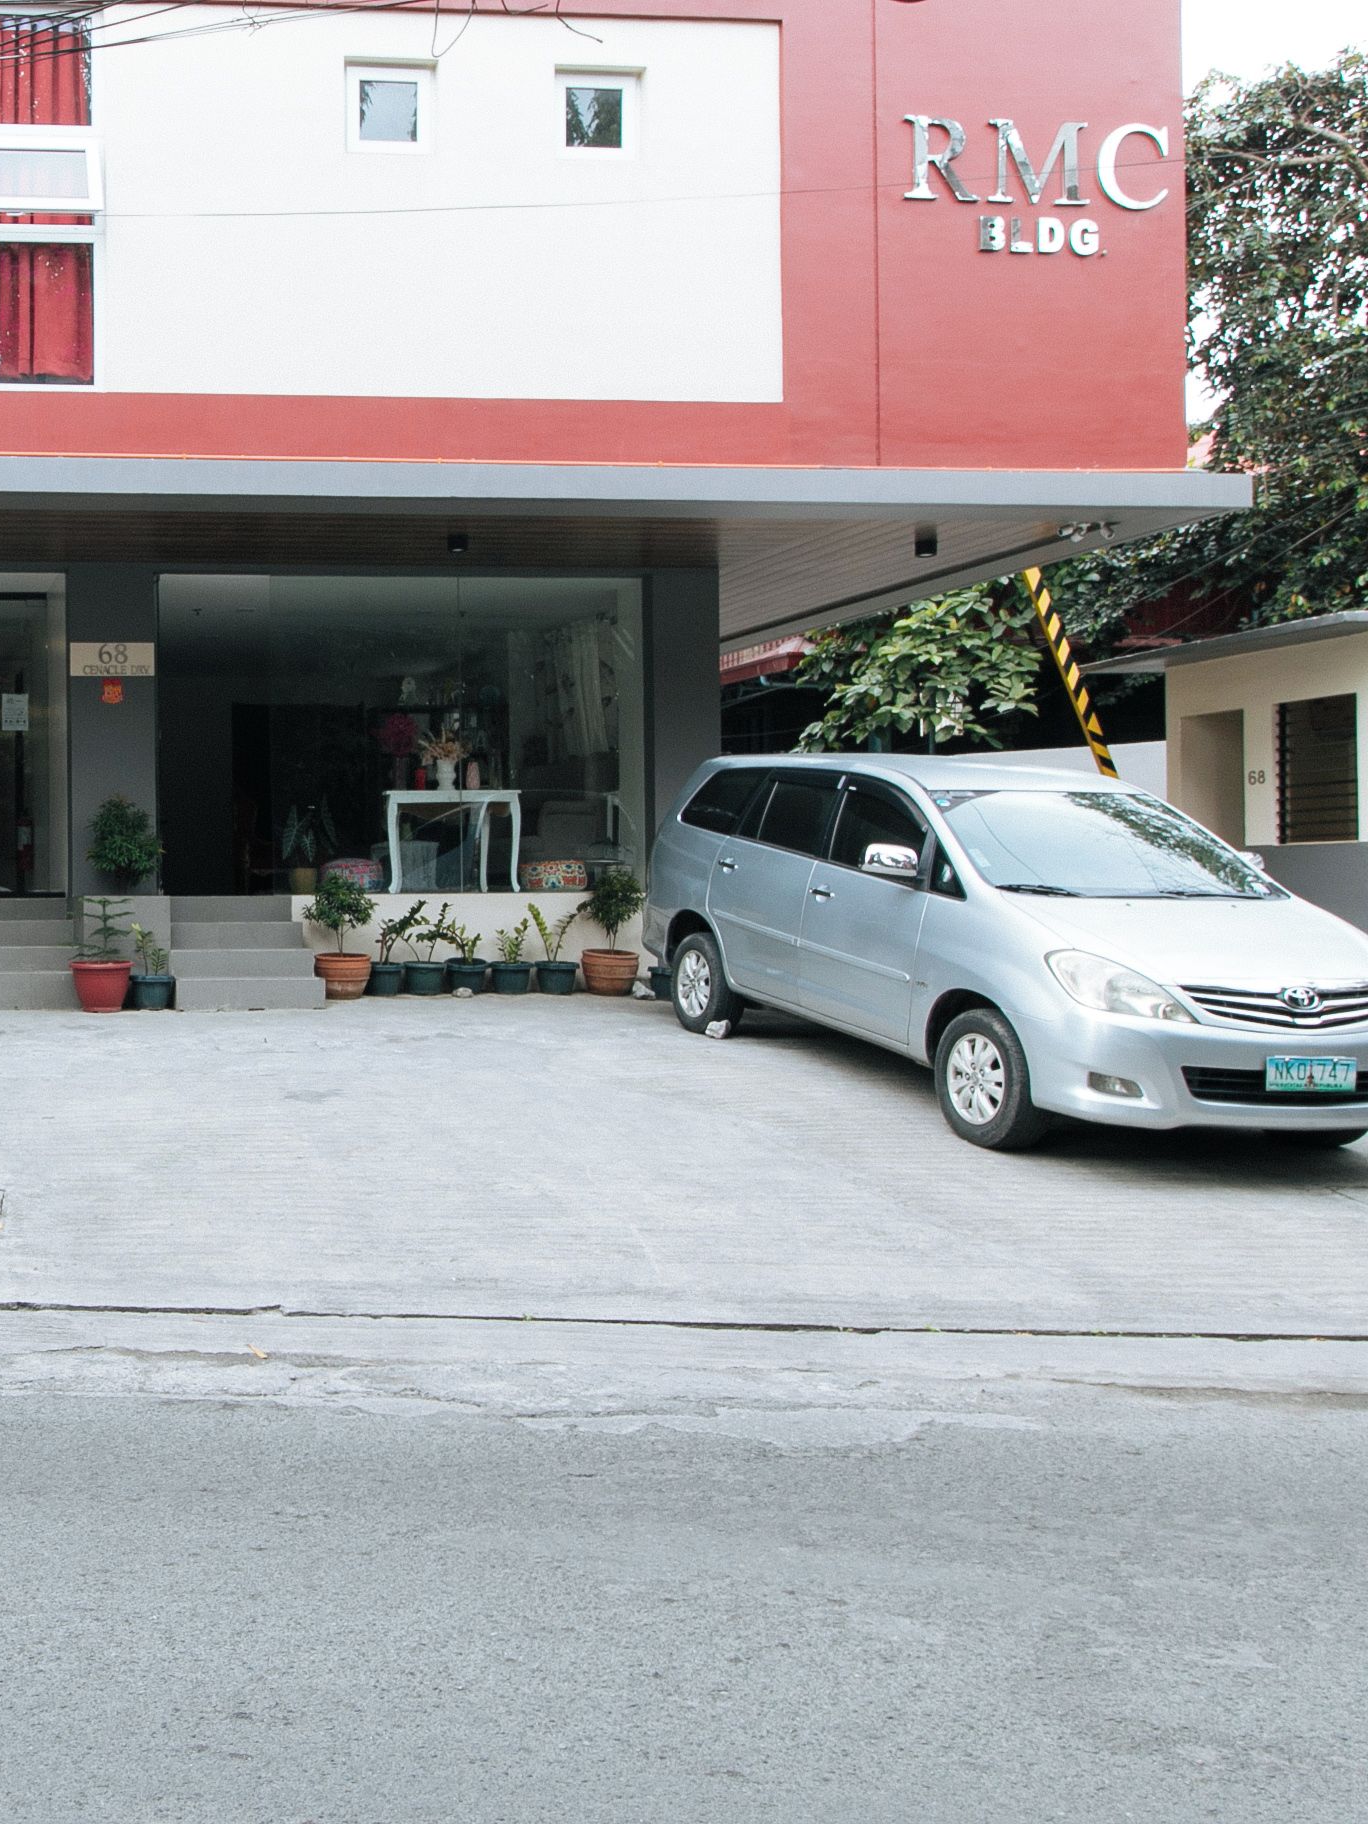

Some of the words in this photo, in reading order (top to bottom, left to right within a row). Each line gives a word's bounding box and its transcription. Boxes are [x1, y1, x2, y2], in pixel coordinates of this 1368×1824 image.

[903, 114, 1169, 211] RMC
[98, 643, 129, 664] 68
[82, 664, 128, 675] CENACLE
[1247, 769, 1266, 786] 68
[1317, 1062, 1351, 1082] 747
